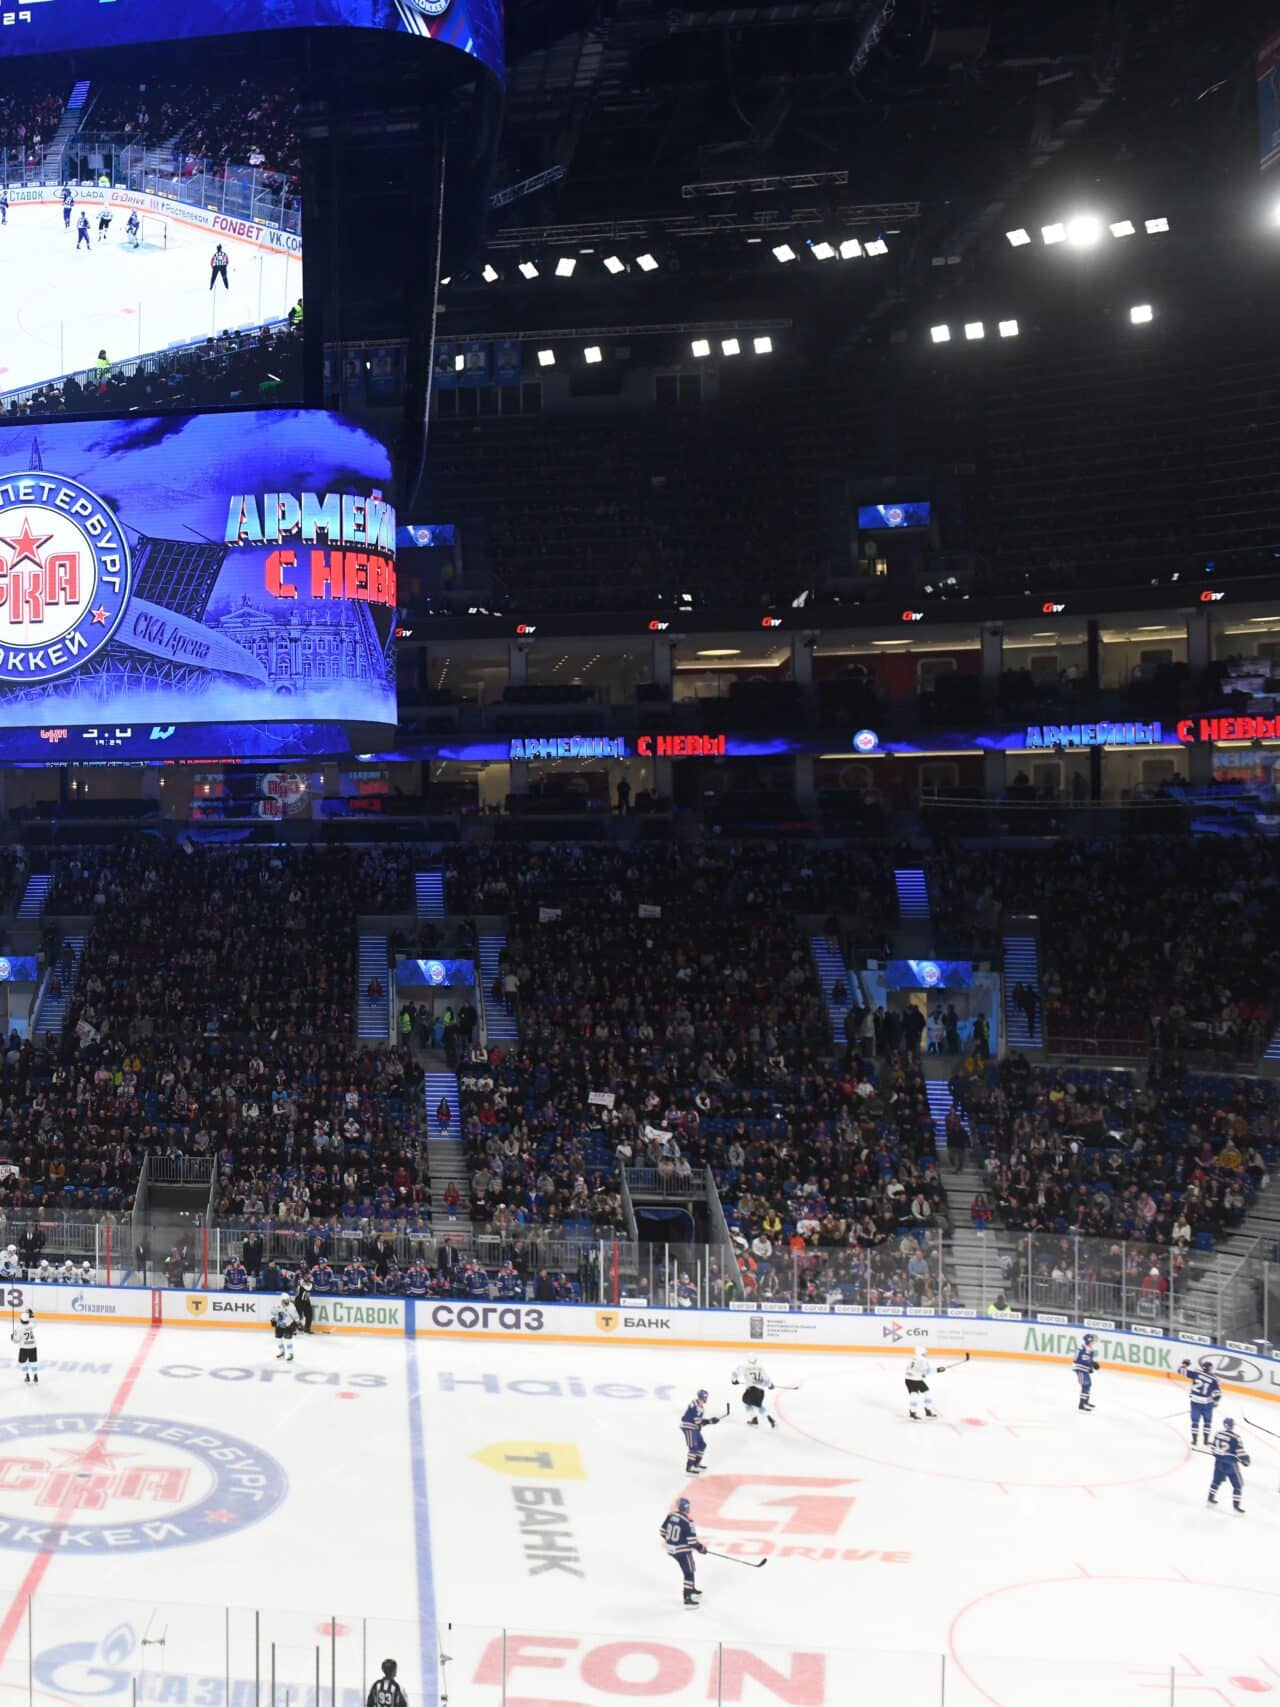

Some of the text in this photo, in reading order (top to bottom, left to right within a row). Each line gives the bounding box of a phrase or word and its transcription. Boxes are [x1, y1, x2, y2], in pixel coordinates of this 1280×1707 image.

[212, 215, 263, 241] FONBET
[264, 550, 298, 600] С
[656, 734, 726, 757] НЕВЫ
[1025, 719, 1162, 749] АРМЕЙЦЫ
[509, 734, 625, 761] АРМЕЙЦЫ
[212, 1301, 257, 1313] БАНК
[623, 1316, 671, 1329] БАНК
[905, 1327, 930, 1339] сбп
[437, 1372, 677, 1400] Haier
[1192, 1378, 1210, 1396] 21
[511, 1485, 587, 1580] БАНК
[472, 1634, 827, 1707] FON
[376, 1692, 392, 1705] 93
